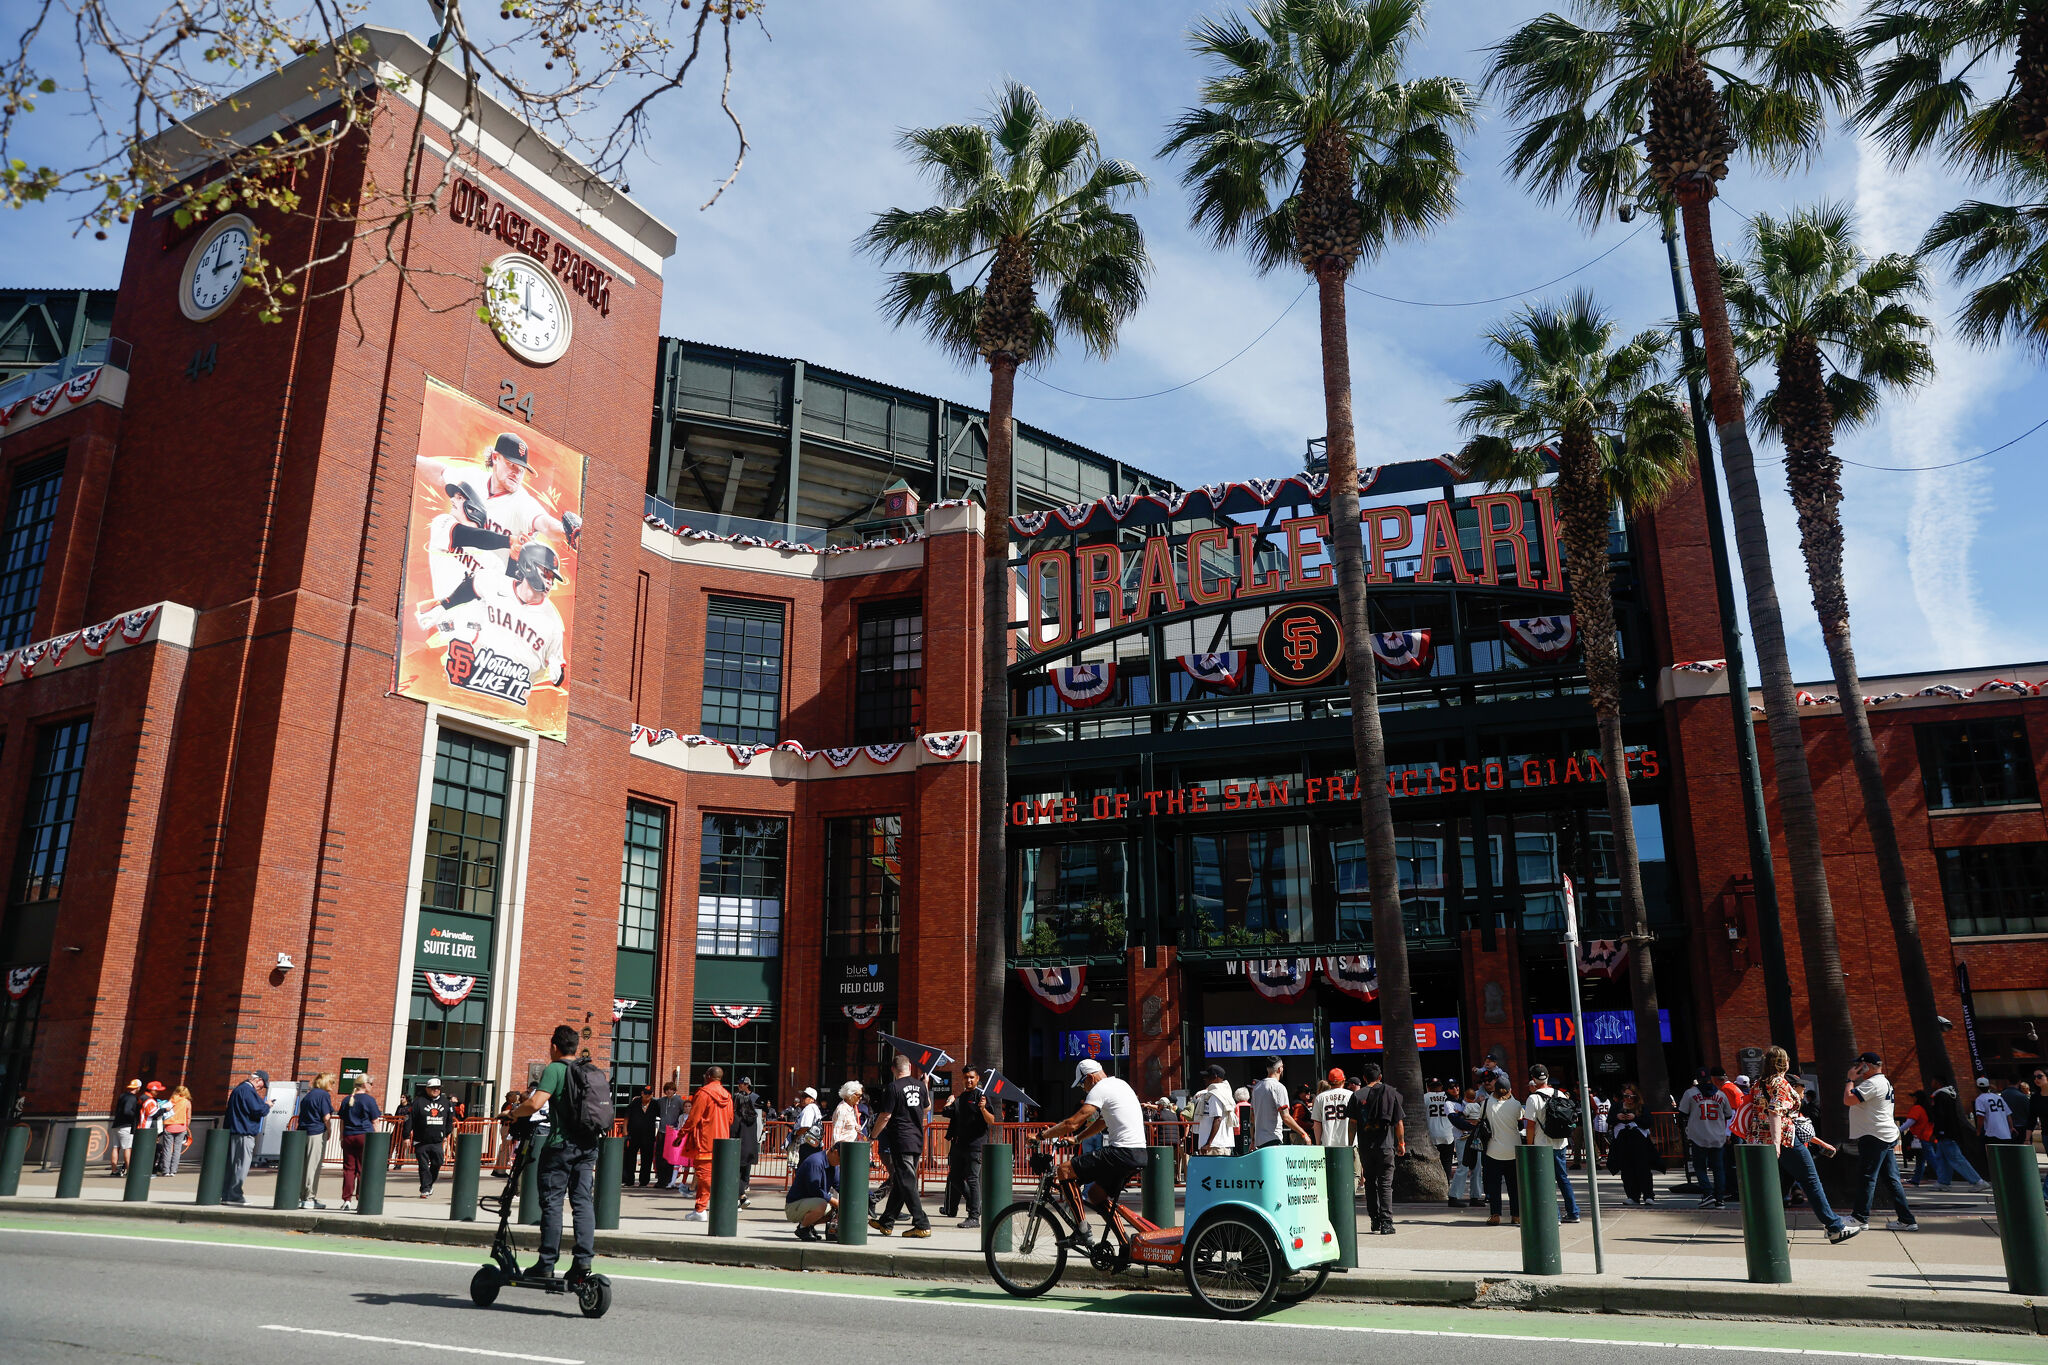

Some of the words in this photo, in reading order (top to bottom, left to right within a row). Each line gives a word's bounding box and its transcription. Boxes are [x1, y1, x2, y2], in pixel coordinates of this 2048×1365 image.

[221, 234, 229, 244] 12
[234, 234, 237, 242] 1
[212, 244, 218, 253] 11
[450, 177, 549, 262] ORACLE
[552, 242, 612, 317] PARK
[202, 257, 209, 268] 10
[239, 254, 244, 263] 3
[196, 274, 200, 283] 9
[232, 272, 237, 280] 4
[196, 288, 201, 296] 8
[223, 285, 228, 295] 5
[203, 294, 208, 304] 7
[212, 294, 216, 303] 6
[549, 304, 553, 313] 2
[551, 320, 556, 329] 3
[535, 337, 539, 345] 5
[545, 333, 549, 341] 4
[185, 343, 217, 380] 44
[499, 379, 534, 422] 24
[1028, 514, 1333, 654] ORACLE
[487, 605, 545, 651] GIANTS
[1281, 616, 1321, 670] SF
[470, 667, 509, 691] LIKE
[1093, 792, 1130, 820] OF
[1144, 786, 1209, 816] THE
[1224, 780, 1289, 810] SAN
[441, 929, 474, 941] Airwallex
[423, 940, 450, 956] SUITE
[451, 943, 477, 959] LEVEL
[846, 964, 868, 975] blue
[1226, 959, 1288, 975] WILLIE
[1300, 956, 1348, 972] MAYS
[840, 983, 861, 994] FIELD
[863, 981, 885, 993] CLUB
[1207, 1029, 1249, 1053] NIGHT
[1251, 1029, 1287, 1051] 2026
[1375, 1027, 1426, 1045] LE
[918, 1051, 932, 1065] N
[993, 1079, 1004, 1094] N
[906, 1092, 920, 1107] 26
[1987, 1098, 2005, 1113] 24
[1325, 1104, 1347, 1121] 28
[1700, 1103, 1719, 1120] 15
[1285, 1157, 1298, 1170] Your
[1298, 1157, 1309, 1172] only
[1215, 1179, 1265, 1189] ELISITY
[1286, 1174, 1308, 1190] Wishing
[1307, 1178, 1317, 1190] you
[1287, 1194, 1302, 1206] knew
[1302, 1194, 1320, 1205] sooner.
